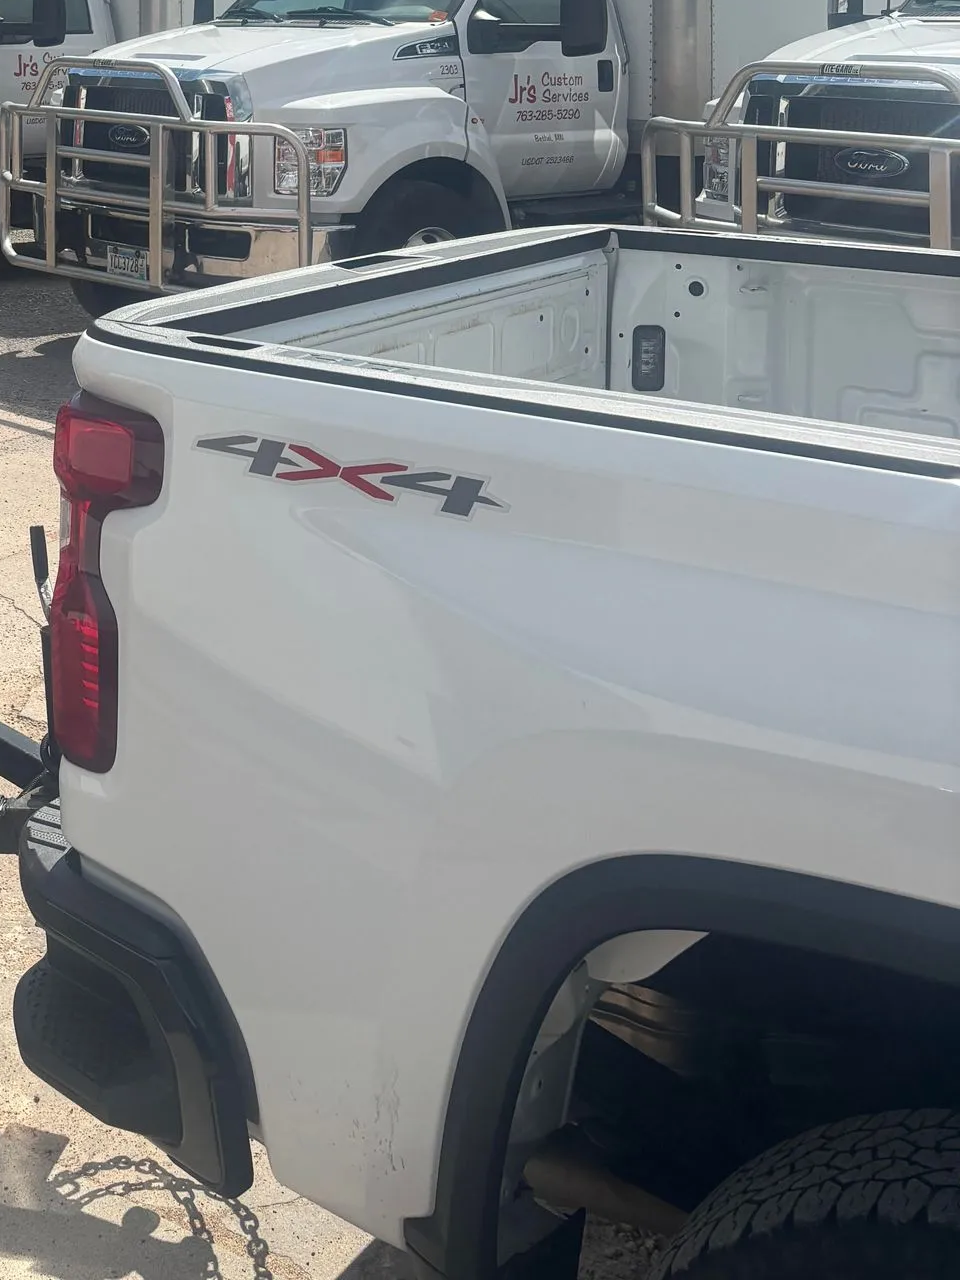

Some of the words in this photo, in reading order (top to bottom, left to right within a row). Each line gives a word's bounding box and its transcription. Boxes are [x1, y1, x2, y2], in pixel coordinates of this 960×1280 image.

[13, 54, 39, 77] Jr's
[541, 71, 583, 87] Custom
[508, 73, 537, 104] Jr's
[541, 87, 590, 103] Services
[516, 108, 581, 122] 763-285-5290
